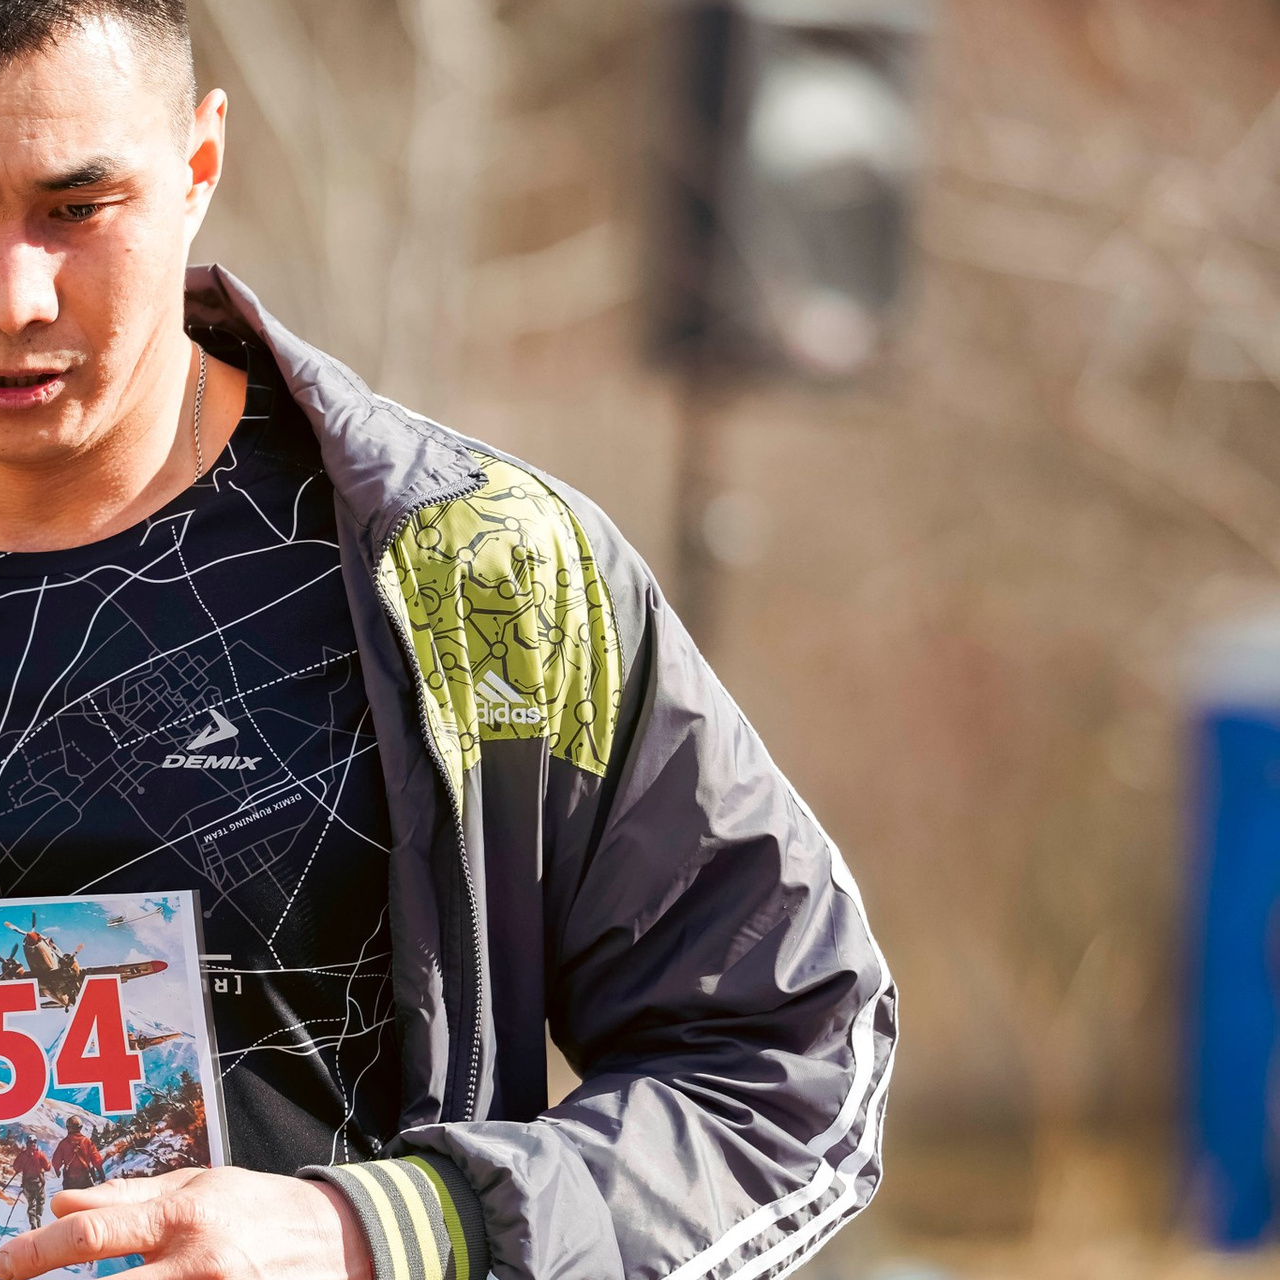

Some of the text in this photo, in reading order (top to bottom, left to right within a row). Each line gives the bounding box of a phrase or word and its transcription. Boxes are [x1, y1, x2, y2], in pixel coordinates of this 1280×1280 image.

[476, 702, 541, 725] didas
[162, 754, 263, 771] DEMIX
[203, 793, 302, 843] DEMIX RUNNING TEAM
